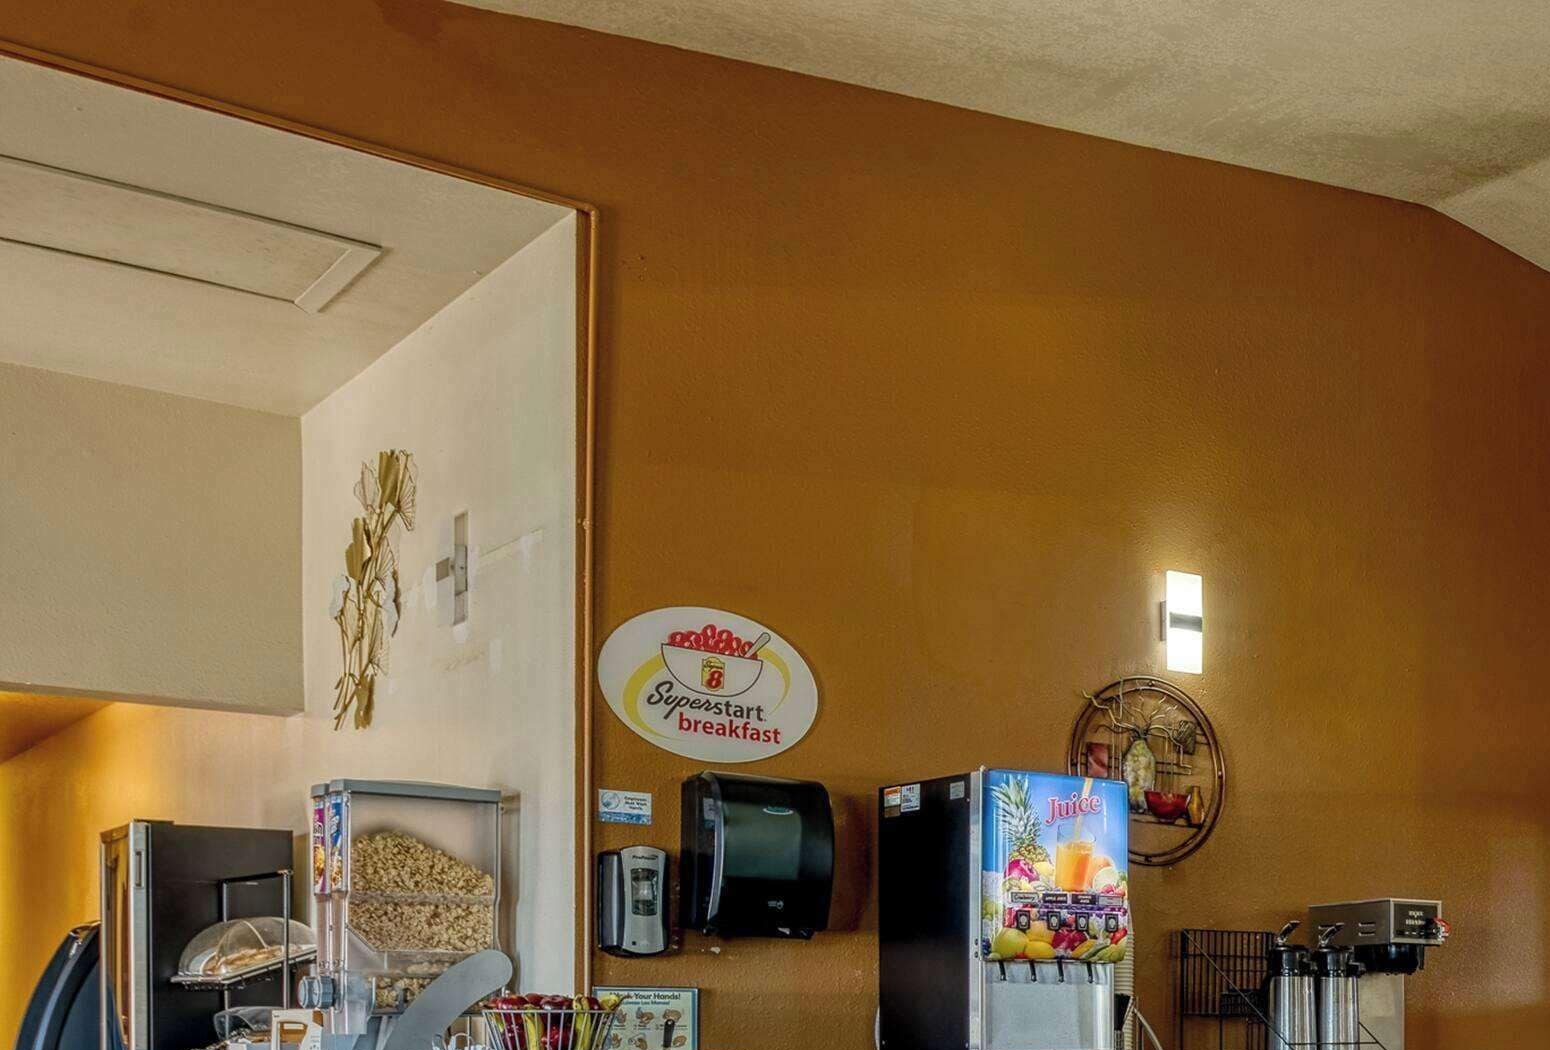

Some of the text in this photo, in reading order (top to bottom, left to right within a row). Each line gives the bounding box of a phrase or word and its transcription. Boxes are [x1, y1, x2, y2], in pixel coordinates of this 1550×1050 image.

[706, 670, 723, 689] 8
[647, 681, 765, 722] Superstart
[678, 712, 780, 744] breakfast
[1045, 792, 1101, 825] Juice
